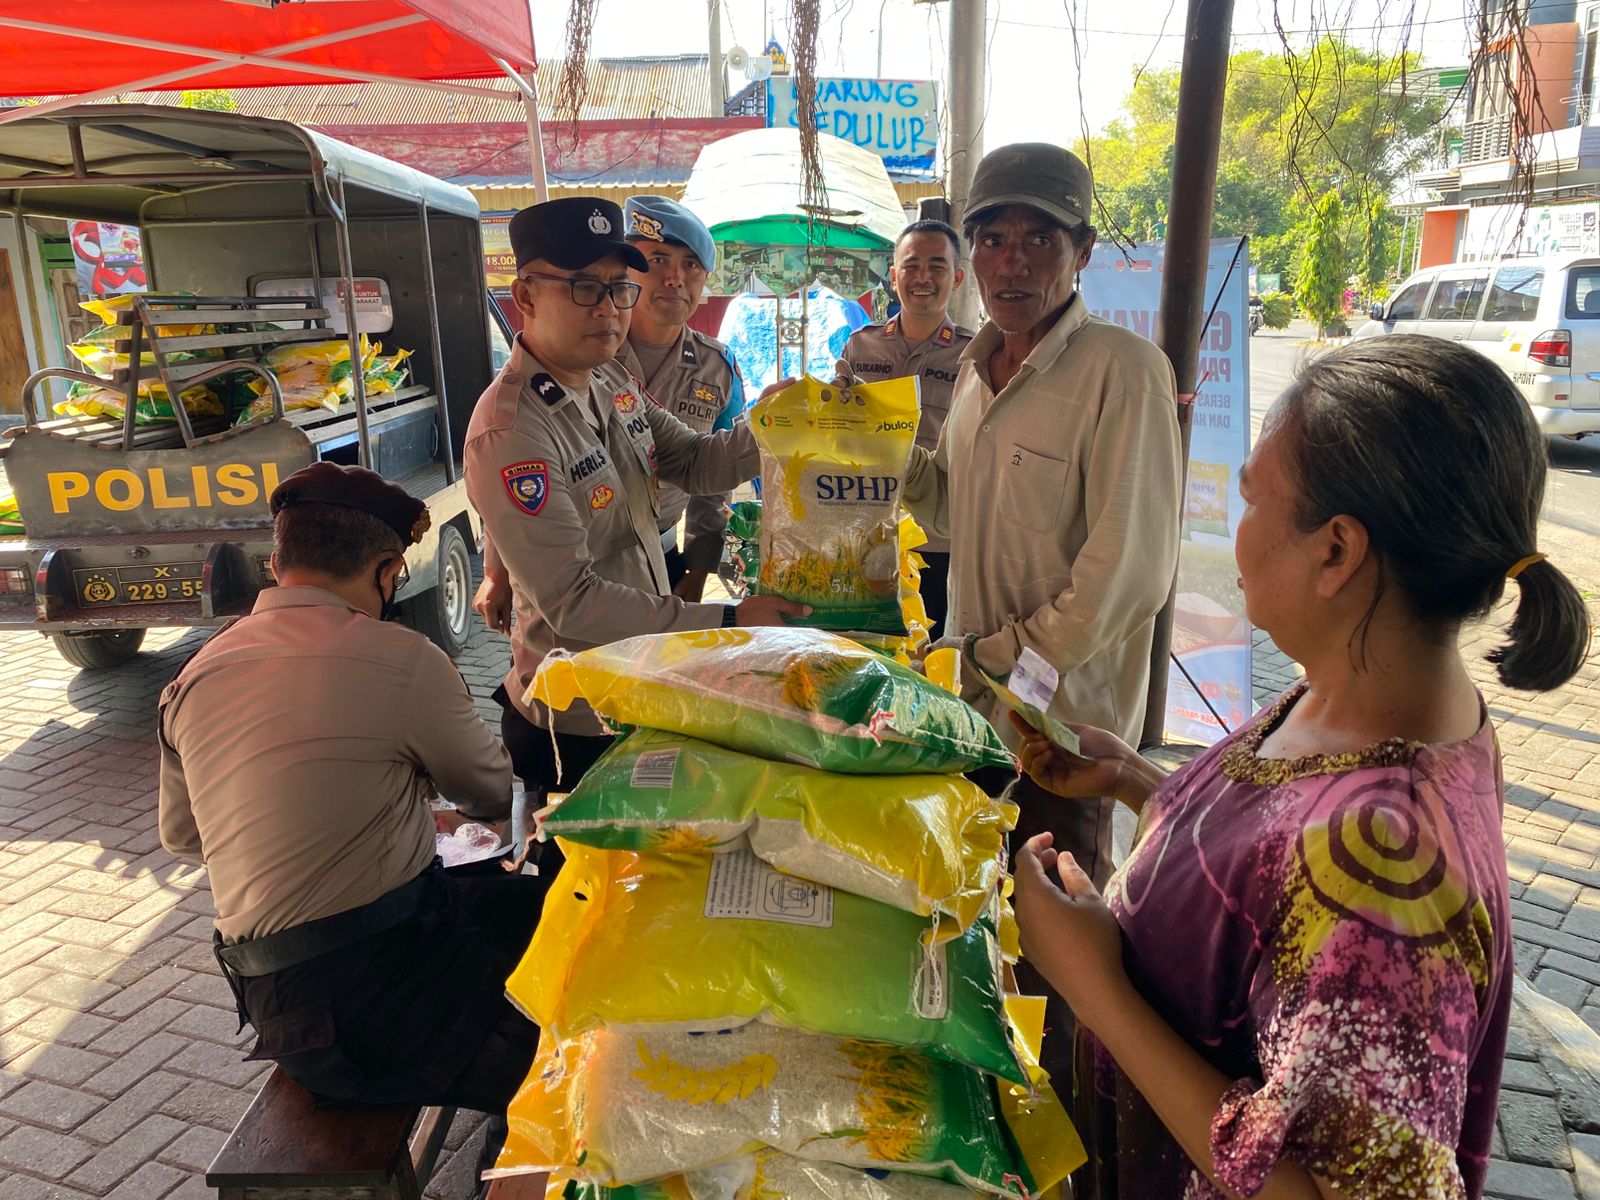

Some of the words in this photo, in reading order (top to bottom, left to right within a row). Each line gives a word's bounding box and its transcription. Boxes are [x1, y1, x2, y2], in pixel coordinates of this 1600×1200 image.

[627, 411, 650, 439] POL
[884, 420, 914, 432] bulog
[47, 462, 280, 514] POLISI
[816, 474, 898, 502] SPHP
[153, 566, 171, 578] X
[831, 578, 841, 593] 5
